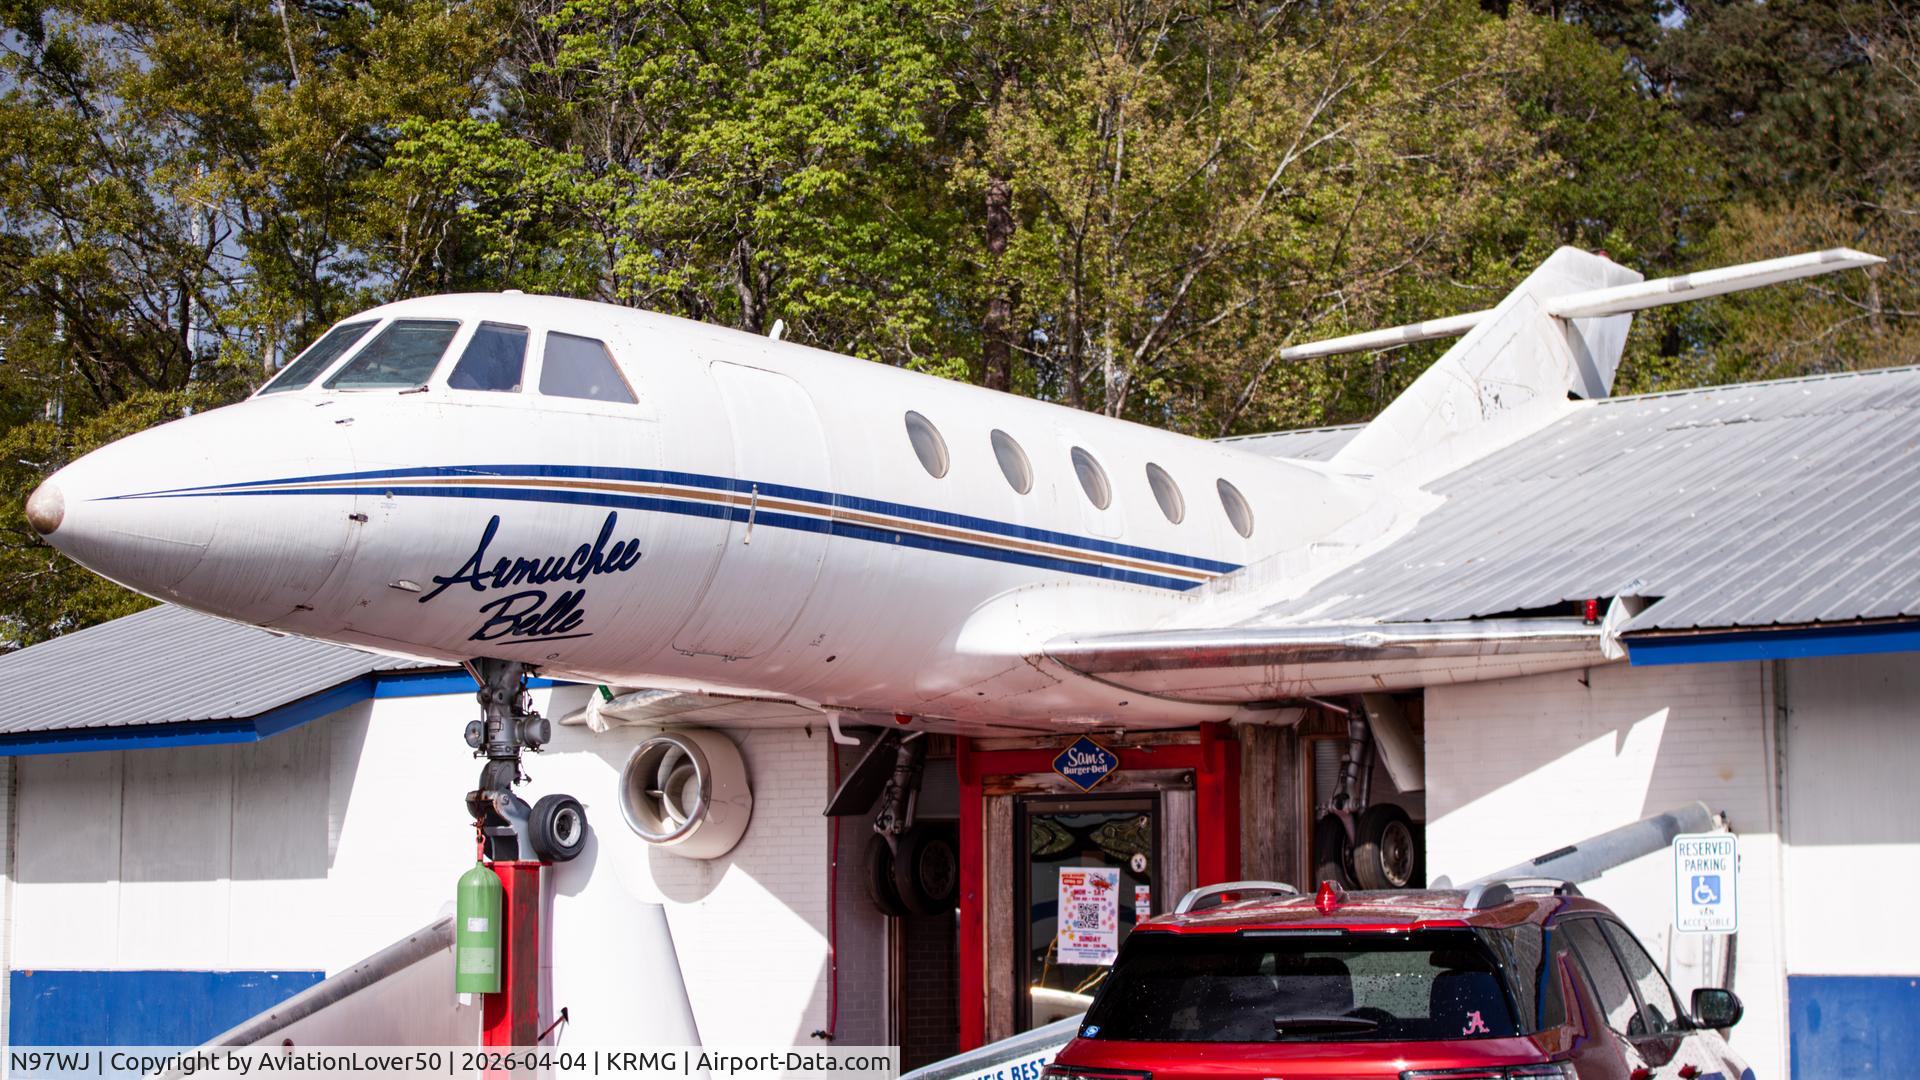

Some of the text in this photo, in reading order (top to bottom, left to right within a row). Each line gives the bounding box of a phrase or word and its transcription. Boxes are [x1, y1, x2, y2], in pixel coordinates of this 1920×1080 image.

[419, 511, 642, 603] Armuchee
[468, 589, 586, 641] Belle
[1068, 747, 1105, 767] Sam's
[1679, 841, 1732, 856] RESERVED
[1684, 858, 1727, 872] PARKING
[1699, 907, 1714, 916] VAN
[1683, 917, 1730, 927] ACCESSIBLE
[1078, 935, 1102, 943] SUNDAY
[1462, 1010, 1490, 1036] A
